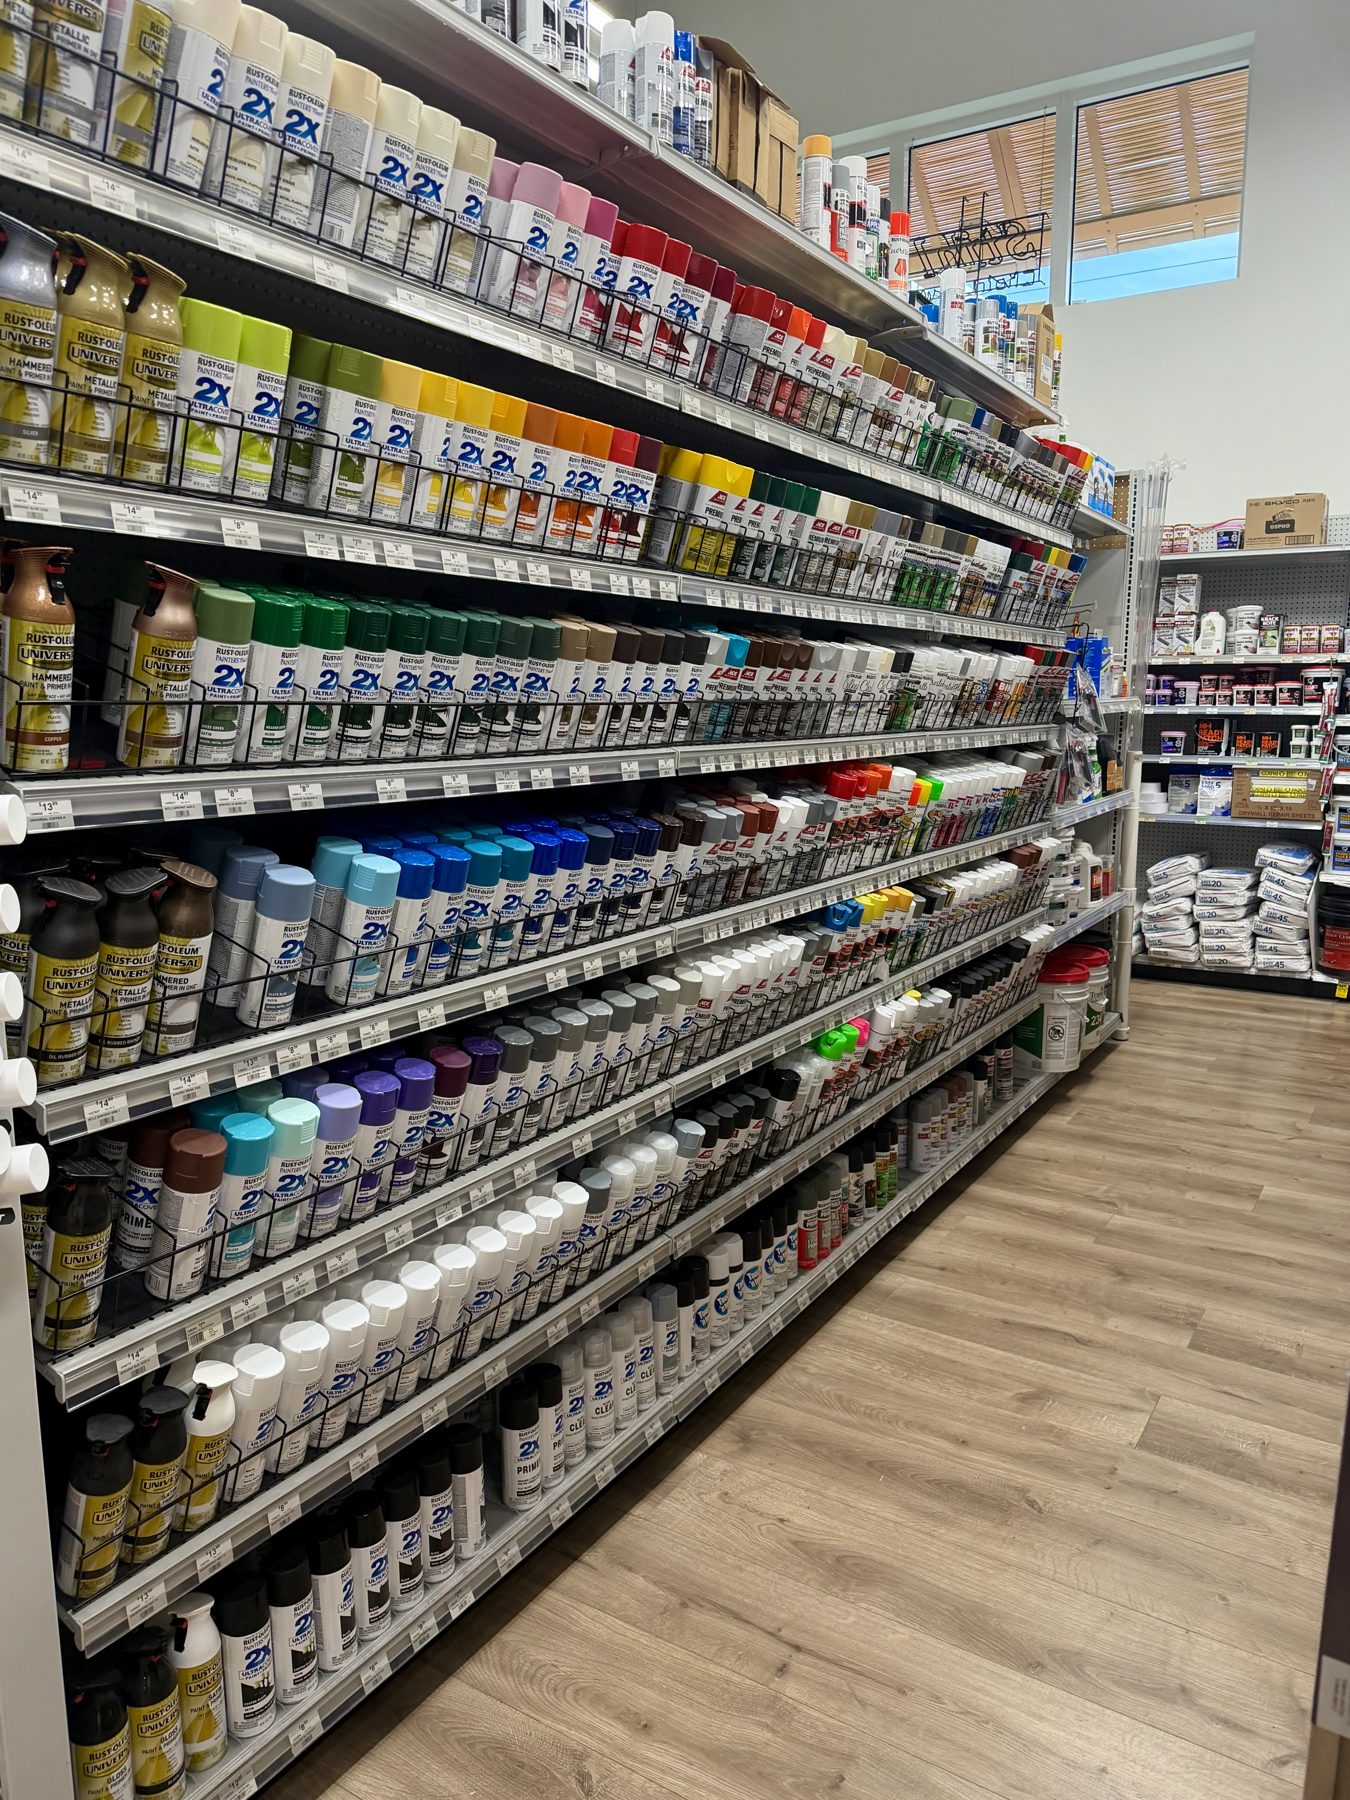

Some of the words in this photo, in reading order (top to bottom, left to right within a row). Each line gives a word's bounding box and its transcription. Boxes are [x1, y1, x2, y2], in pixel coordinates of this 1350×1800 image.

[241, 87, 276, 124] 2X
[283, 108, 320, 144] 2X
[380, 155, 411, 187] 2X
[411, 172, 445, 203] 2X
[627, 276, 654, 299] 2X
[676, 299, 702, 322] 2X
[193, 377, 231, 408] 2X
[253, 391, 283, 418] 2X
[458, 442, 485, 465] 2X
[490, 450, 517, 473] 2X
[577, 471, 602, 493] 2X
[627, 484, 650, 505] 2X
[212, 664, 245, 688] 2X
[350, 669, 381, 691] 2X
[427, 671, 456, 691] 2X
[491, 671, 520, 691] 2X
[523, 673, 550, 692] 2X
[1212, 880, 1222, 888] 20
[462, 900, 491, 917] 2X
[1208, 896, 1218, 904] 20
[1206, 911, 1217, 919] 20
[361, 922, 390, 940] 2X
[427, 1111, 455, 1128] 2X
[321, 1156, 351, 1174] 2X
[126, 1180, 160, 1204] 2X
[277, 1174, 307, 1192] 2X
[245, 1646, 272, 1670] 2X
